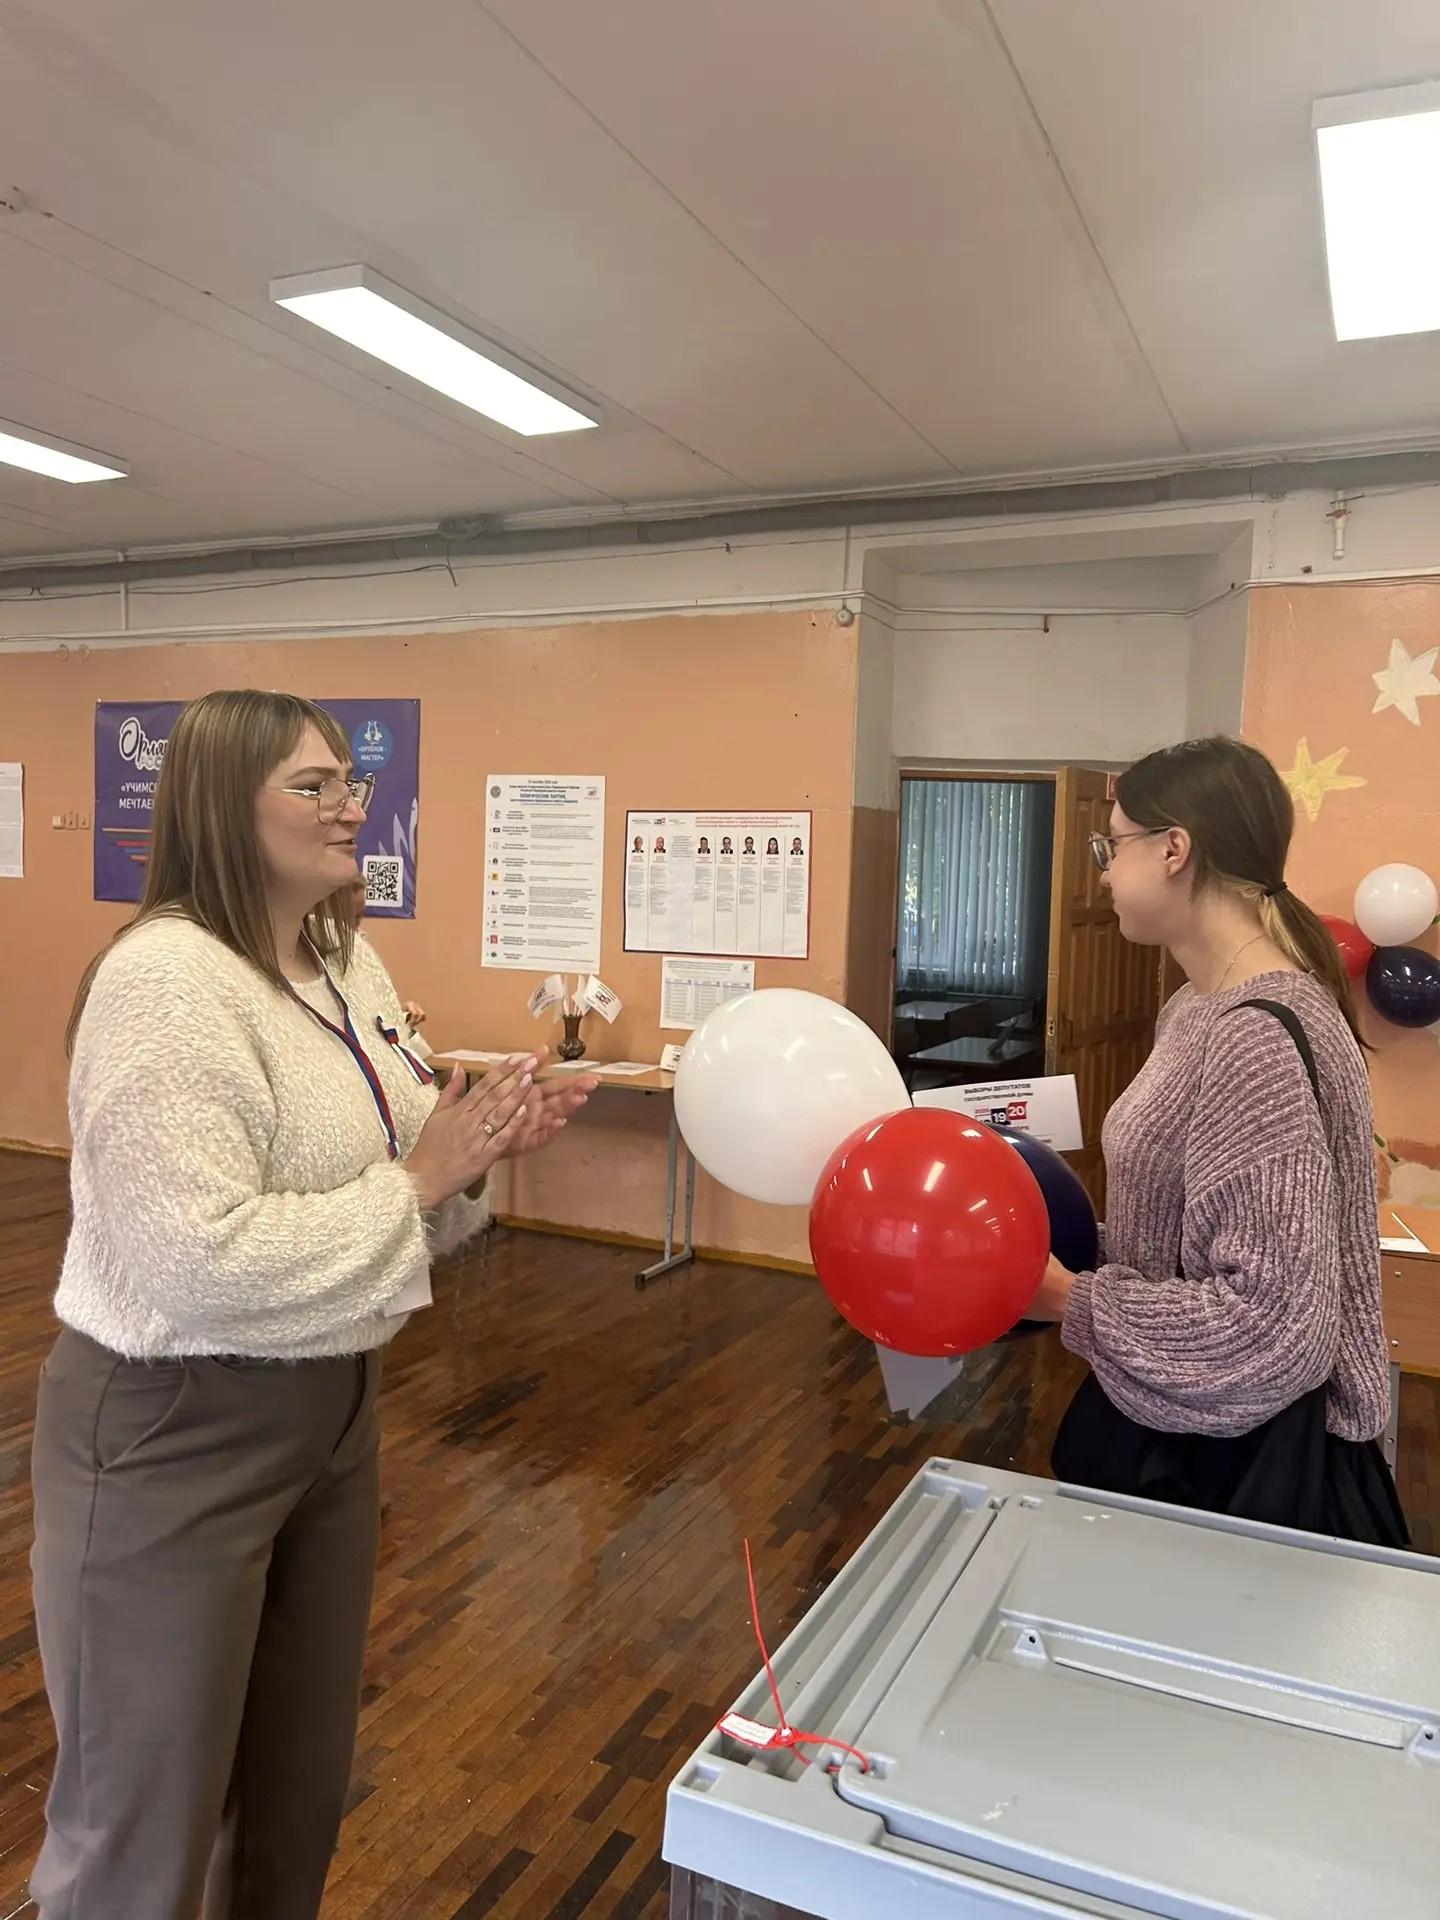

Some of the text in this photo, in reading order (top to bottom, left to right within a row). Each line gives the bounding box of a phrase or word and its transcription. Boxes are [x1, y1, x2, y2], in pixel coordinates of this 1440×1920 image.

[119, 798, 155, 810] МЕЧТАЕ
[964, 1083, 1031, 1095] ВЫБОРЫ ДЕПУТАТОВ
[992, 1105, 1025, 1123] 19 20
